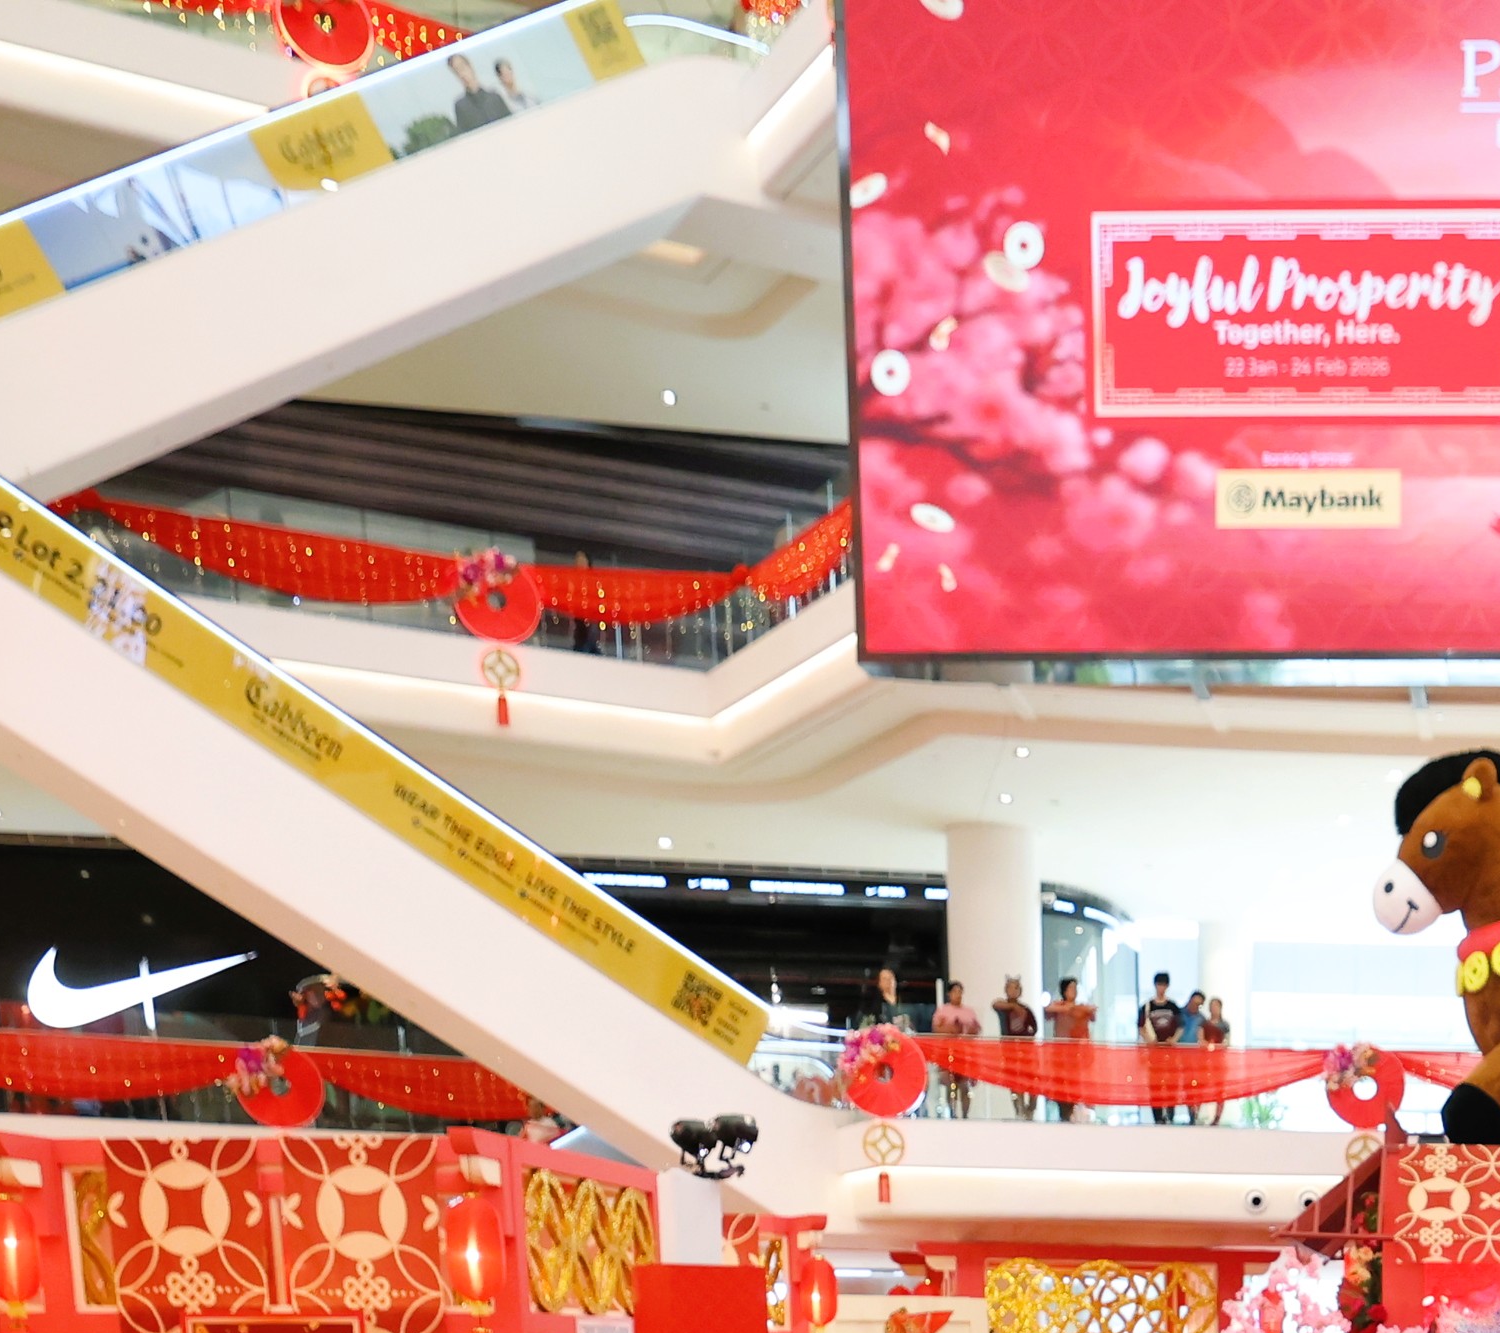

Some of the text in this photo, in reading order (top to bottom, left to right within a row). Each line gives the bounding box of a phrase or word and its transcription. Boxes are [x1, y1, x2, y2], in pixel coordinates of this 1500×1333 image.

[1118, 255, 1258, 327] Joyful
[1215, 319, 1400, 349] Together, Here.
[1246, 356, 1277, 377] Jan
[1315, 356, 1347, 376] Feb
[1263, 486, 1384, 515] Maybank
[16, 524, 62, 570] Lot
